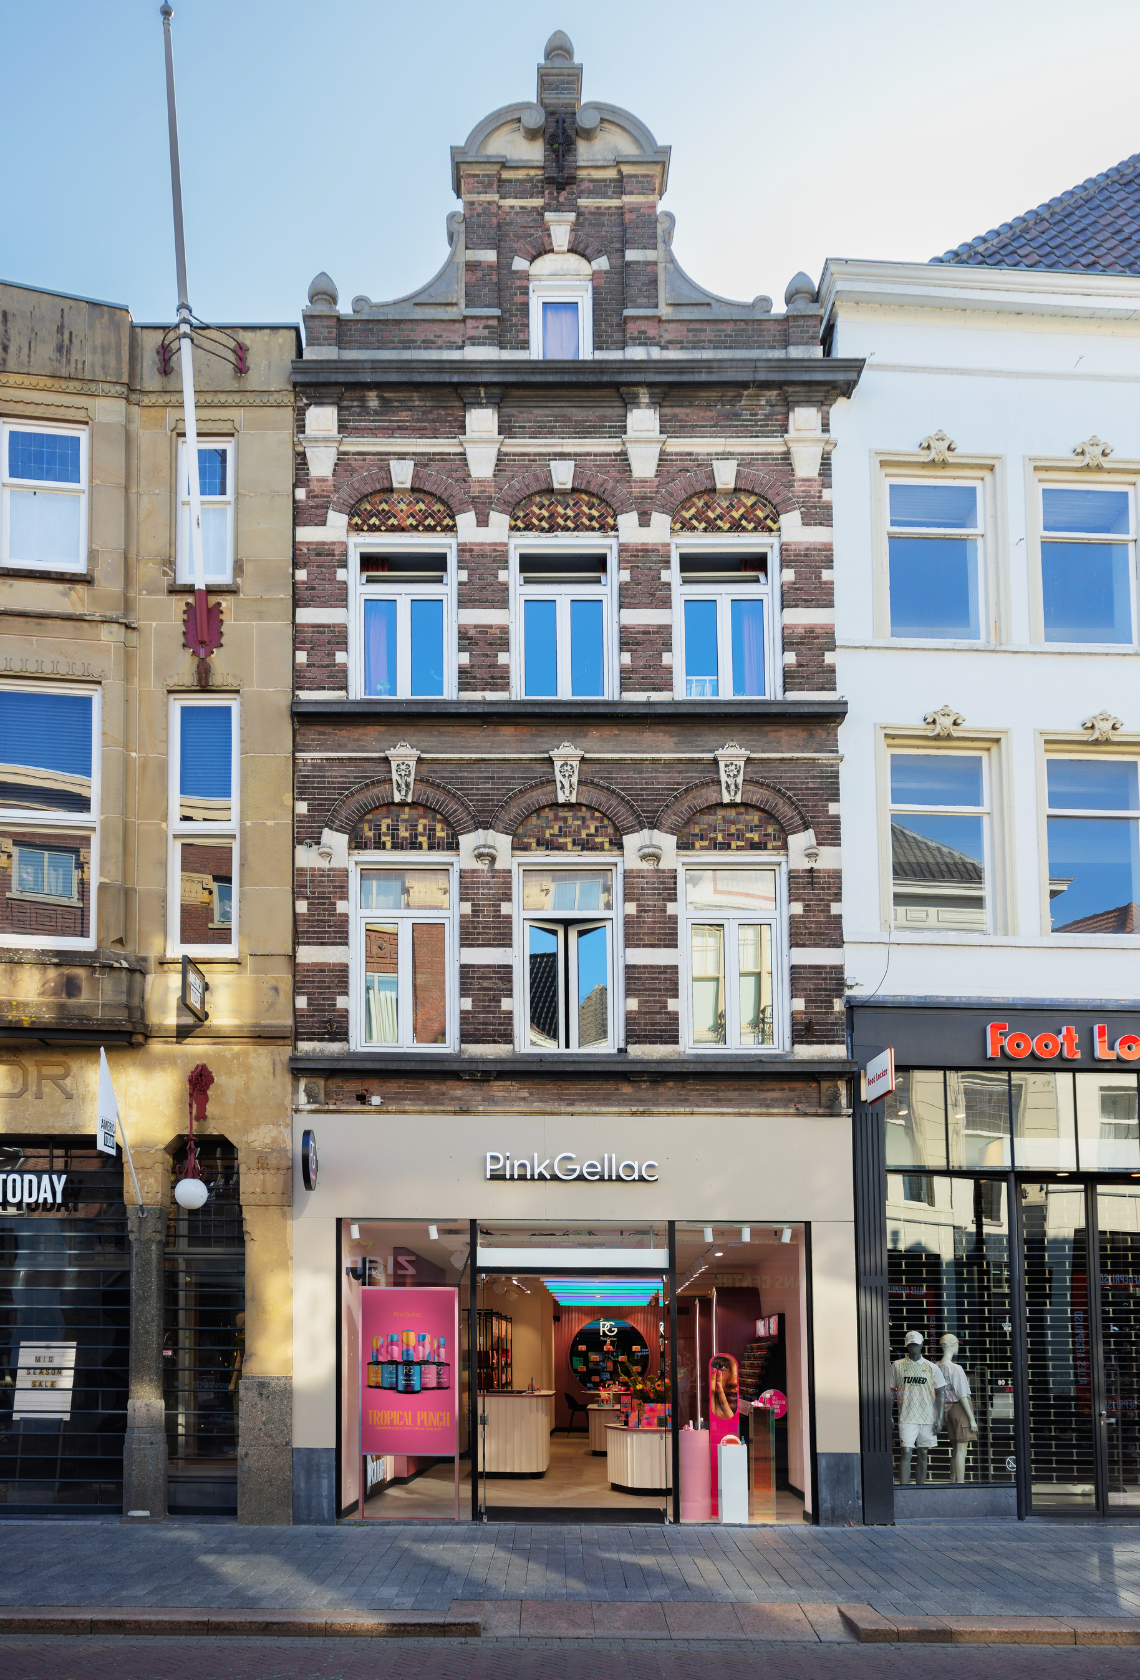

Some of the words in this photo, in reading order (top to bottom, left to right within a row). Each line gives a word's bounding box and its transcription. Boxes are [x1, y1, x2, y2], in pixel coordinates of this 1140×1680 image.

[986, 1022, 1081, 1059] Foot
[867, 1075, 876, 1087] Foot
[875, 1068, 888, 1082] Locker
[486, 1151, 659, 1181] PinkGellac
[0, 1173, 67, 1204] TODAY
[599, 1321, 618, 1336] PG
[903, 1376, 928, 1385] TUNED
[367, 1409, 414, 1426] TROPICAL
[417, 1410, 450, 1427] PUNCH
